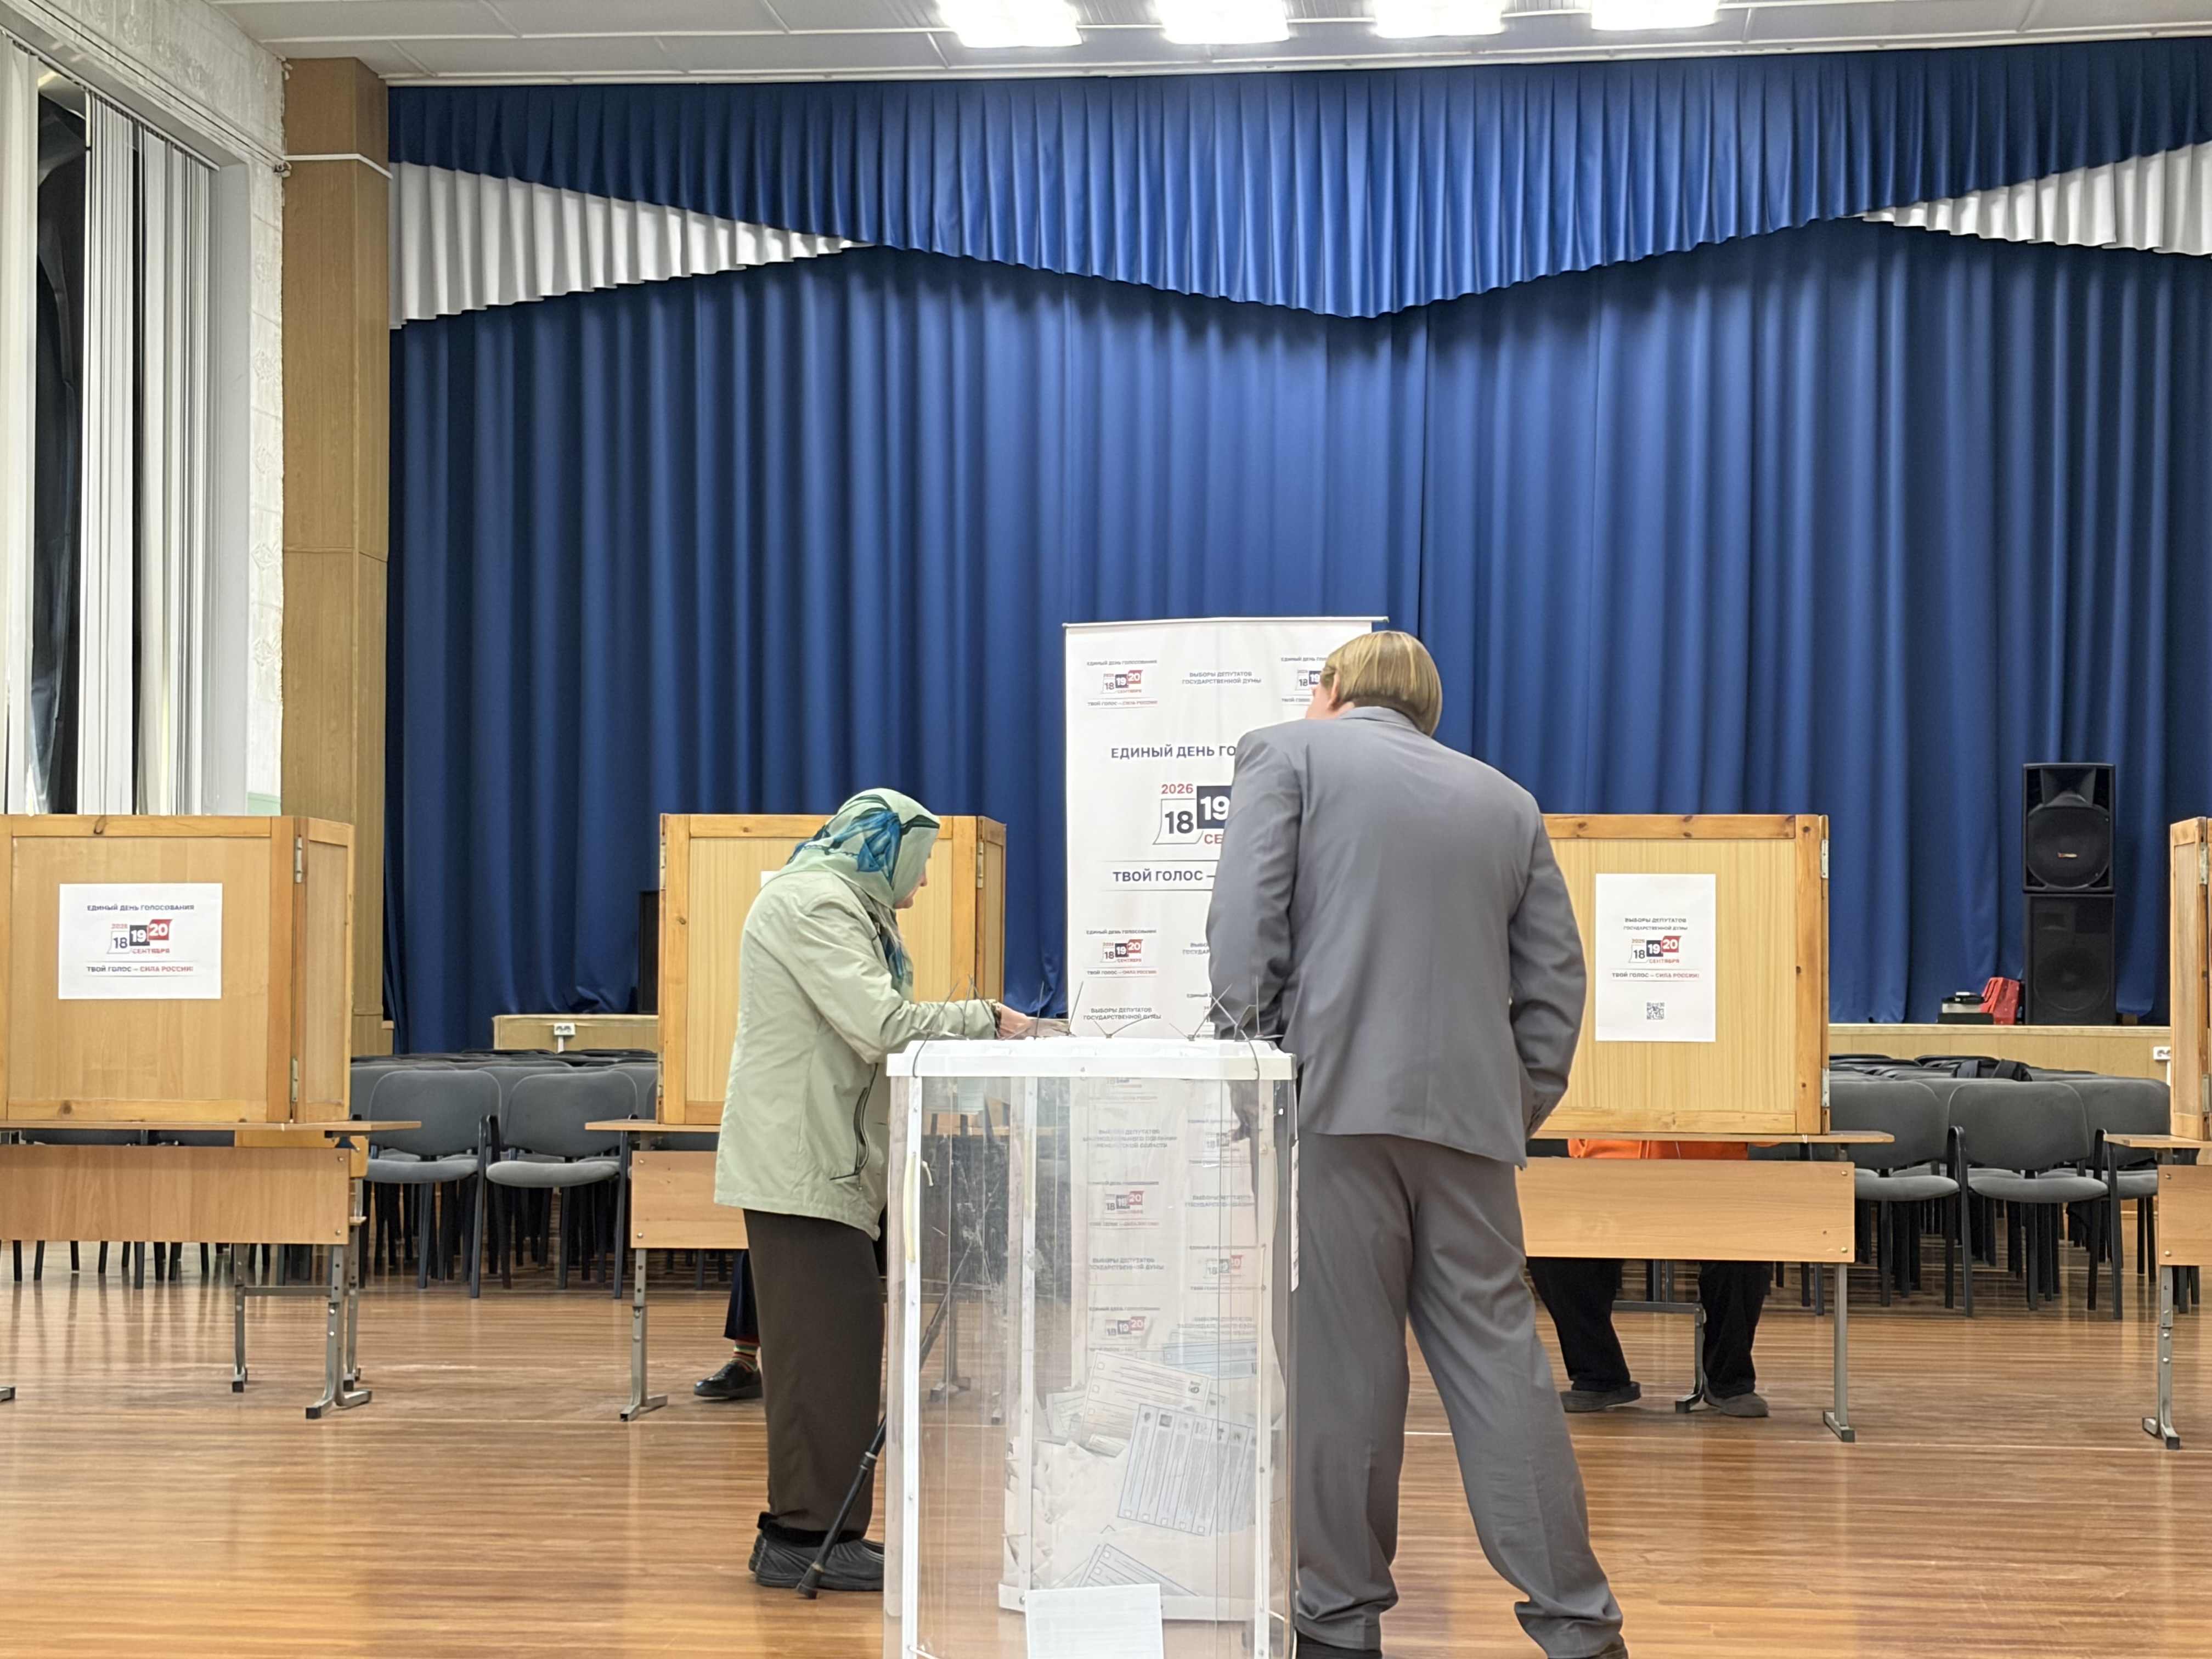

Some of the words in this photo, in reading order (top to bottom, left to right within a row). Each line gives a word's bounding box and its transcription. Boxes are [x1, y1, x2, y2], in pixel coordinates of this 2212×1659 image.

[1116, 677, 1126, 686] 19
[1128, 673, 1141, 681] 20
[1111, 744, 1173, 760] ЕДИНЫЙ
[1176, 746, 1215, 758] ДЕНЬ
[1161, 783, 1194, 794] 2026
[1165, 811, 1194, 834] 18
[1200, 795, 1230, 820] 19
[1113, 868, 1152, 882] ТВОЙ
[1156, 871, 1203, 882] ГОЛОС
[113, 937, 128, 949] 18
[131, 929, 146, 943] 19
[149, 923, 168, 936] 20
[1104, 951, 1114, 959] 18
[1116, 946, 1126, 955] 19
[1128, 942, 1141, 951] 20
[1633, 950, 1645, 959] 18
[1647, 944, 1661, 954] 19
[1662, 939, 1678, 950] 20
[1129, 1194, 1142, 1203] 20
[1131, 1319, 1144, 1328] 20
